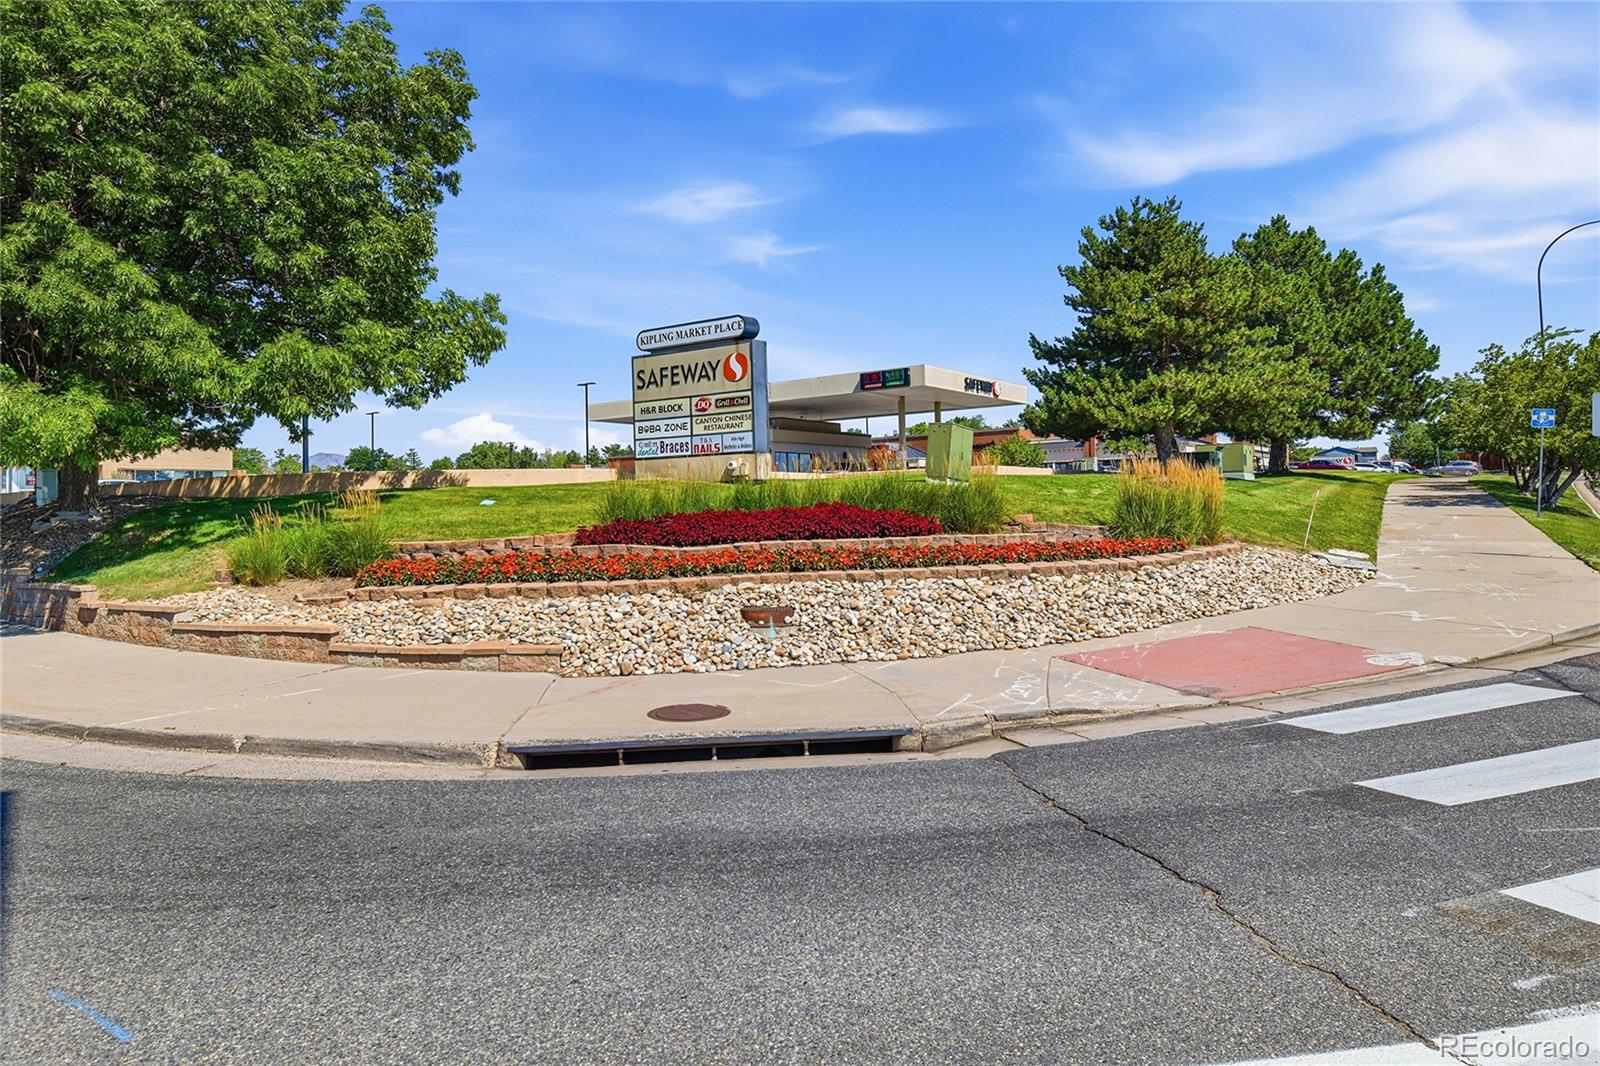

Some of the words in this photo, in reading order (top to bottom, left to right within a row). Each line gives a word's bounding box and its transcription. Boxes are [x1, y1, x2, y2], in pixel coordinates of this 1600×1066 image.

[640, 332, 674, 346] KIPLING
[675, 326, 712, 340] MARKET
[714, 320, 744, 333] PLACE
[636, 359, 721, 390] SAFEWAY
[640, 406, 657, 415] H&R
[658, 403, 683, 413] BLOCK
[697, 400, 710, 409] DQ
[694, 416, 723, 425] CANTON
[724, 413, 752, 422] CHINESE
[638, 424, 661, 434] BOBA
[664, 422, 688, 432] ZONE
[704, 422, 744, 431] RESTAURANT
[660, 441, 690, 454] Braces
[693, 443, 720, 453] NAILS
